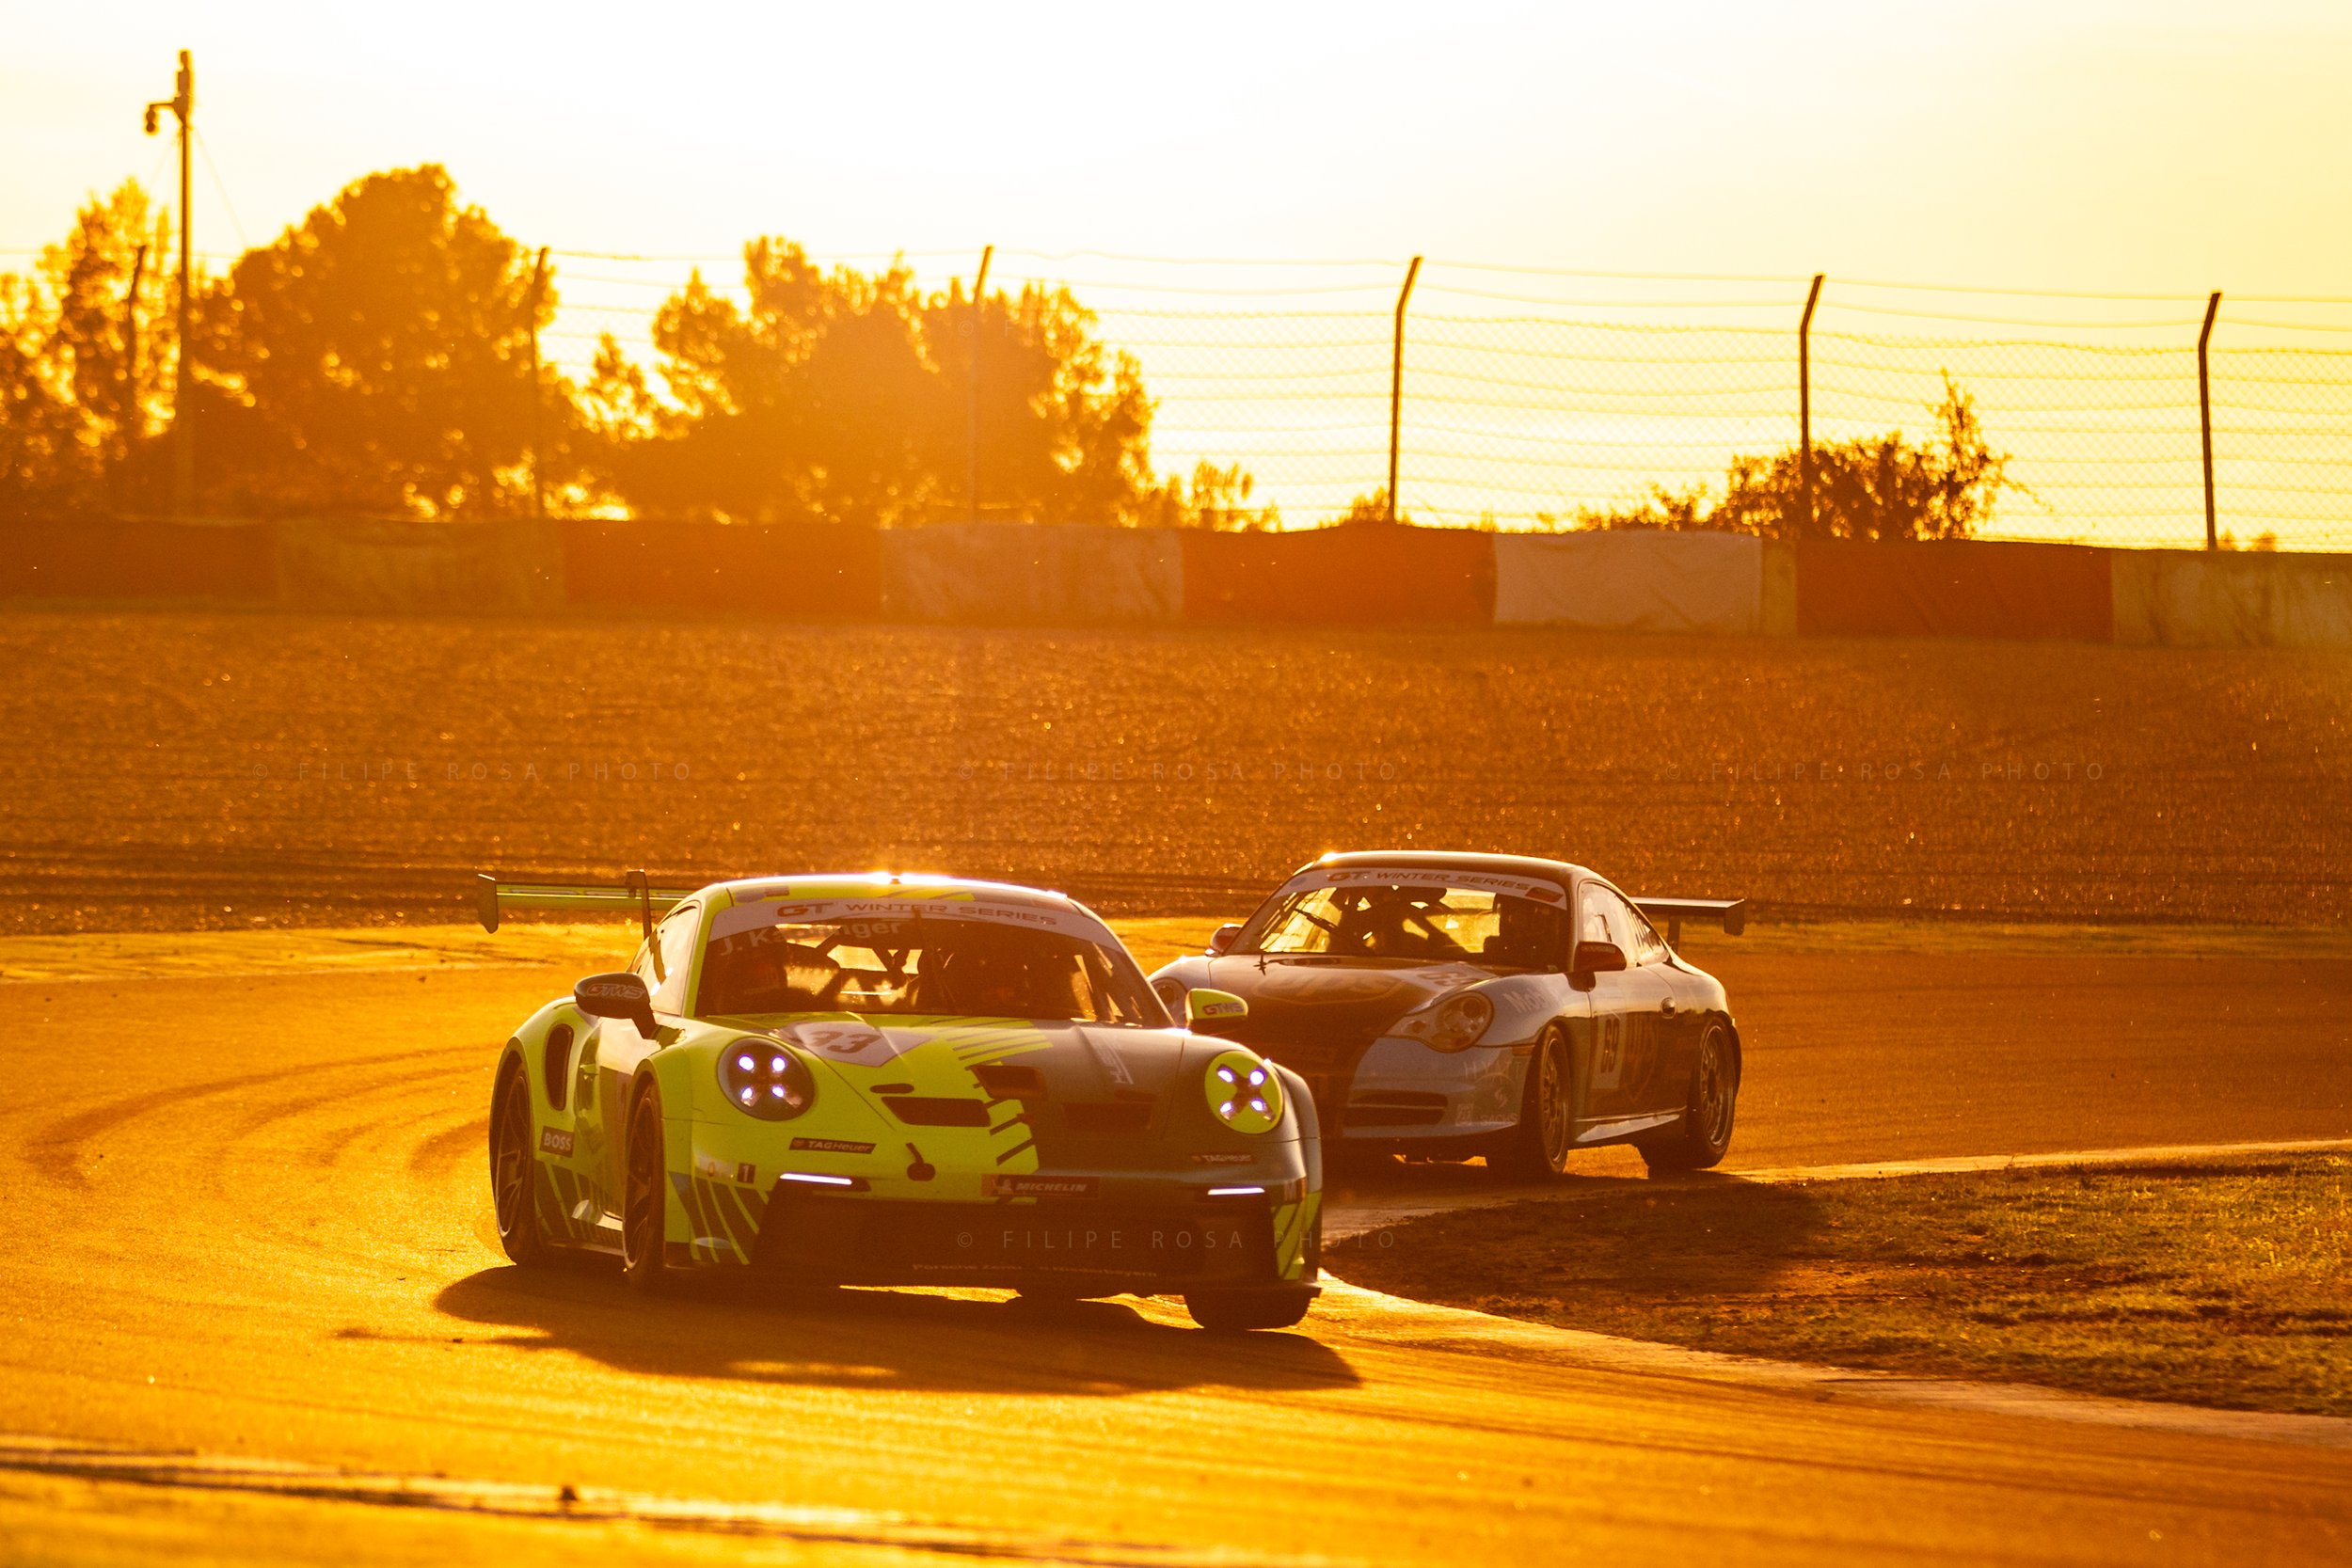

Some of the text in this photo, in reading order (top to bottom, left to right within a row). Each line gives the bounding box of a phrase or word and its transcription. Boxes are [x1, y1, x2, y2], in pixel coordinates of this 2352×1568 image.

[1327, 871, 1530, 891] GT WINTER SERIES
[776, 903, 1057, 926] GT WINTER SERIES
[587, 984, 646, 999] GTWS
[810, 1030, 882, 1053] 33
[543, 1132, 573, 1151] BOSS
[741, 1164, 750, 1182] 1
[1015, 1182, 1088, 1193] MICHELIN
